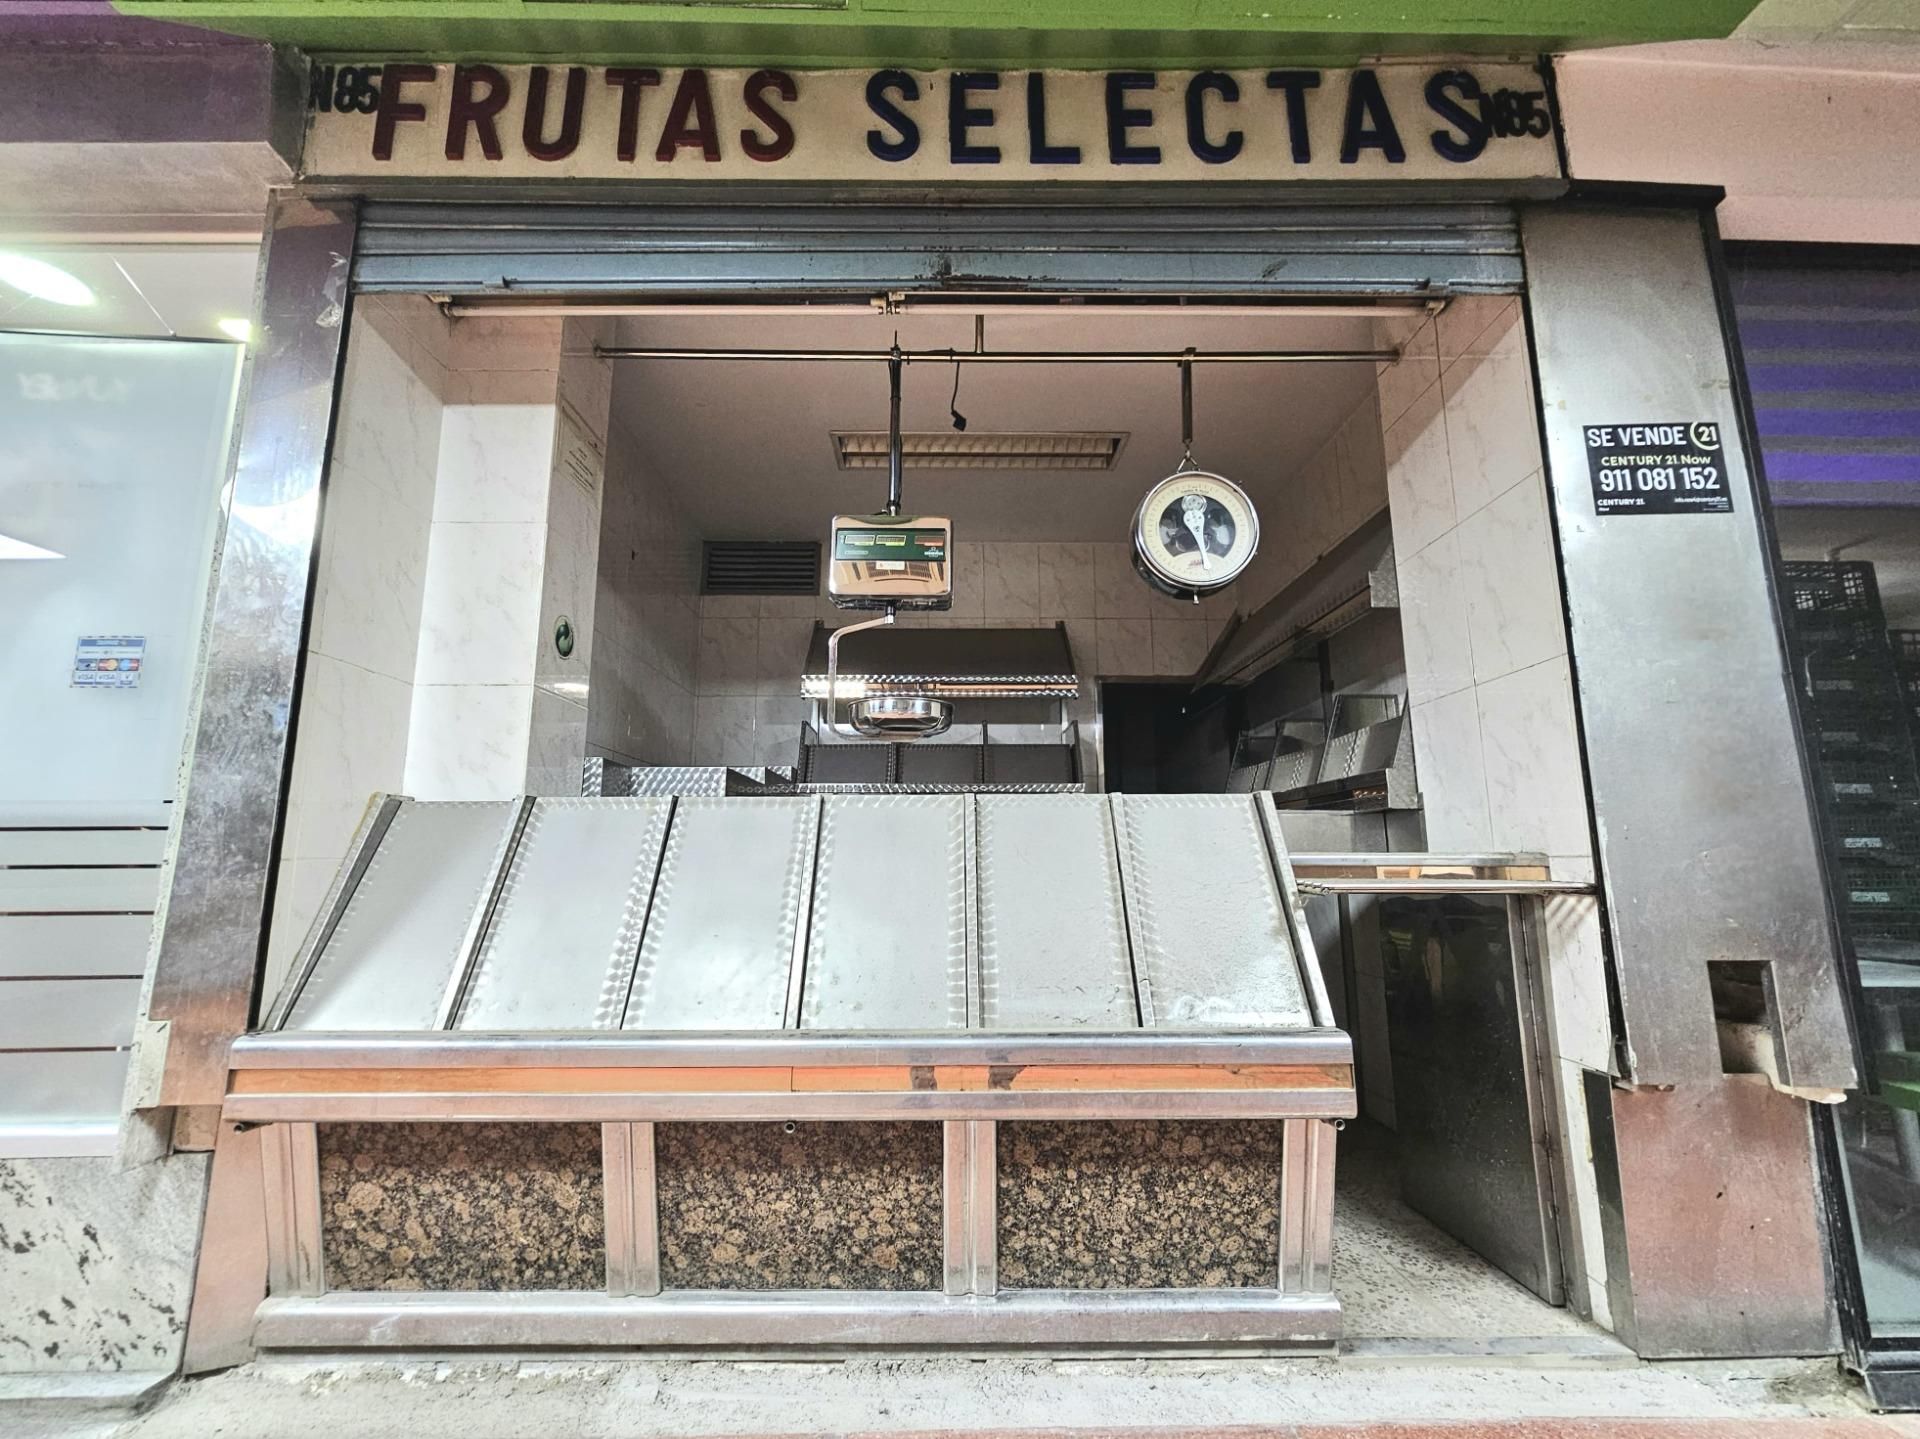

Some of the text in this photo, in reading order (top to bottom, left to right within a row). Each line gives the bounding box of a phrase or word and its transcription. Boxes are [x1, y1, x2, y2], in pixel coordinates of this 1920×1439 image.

[371, 63, 1490, 164] FRUTAS SELECTAS
[1587, 425, 1687, 447] SE VENDE
[1698, 425, 1718, 442] 21
[1601, 455, 1662, 467] CENTURY
[1681, 454, 1711, 465] Now
[1600, 466, 1720, 492] 911 081 152
[1597, 498, 1635, 506] CENTURY
